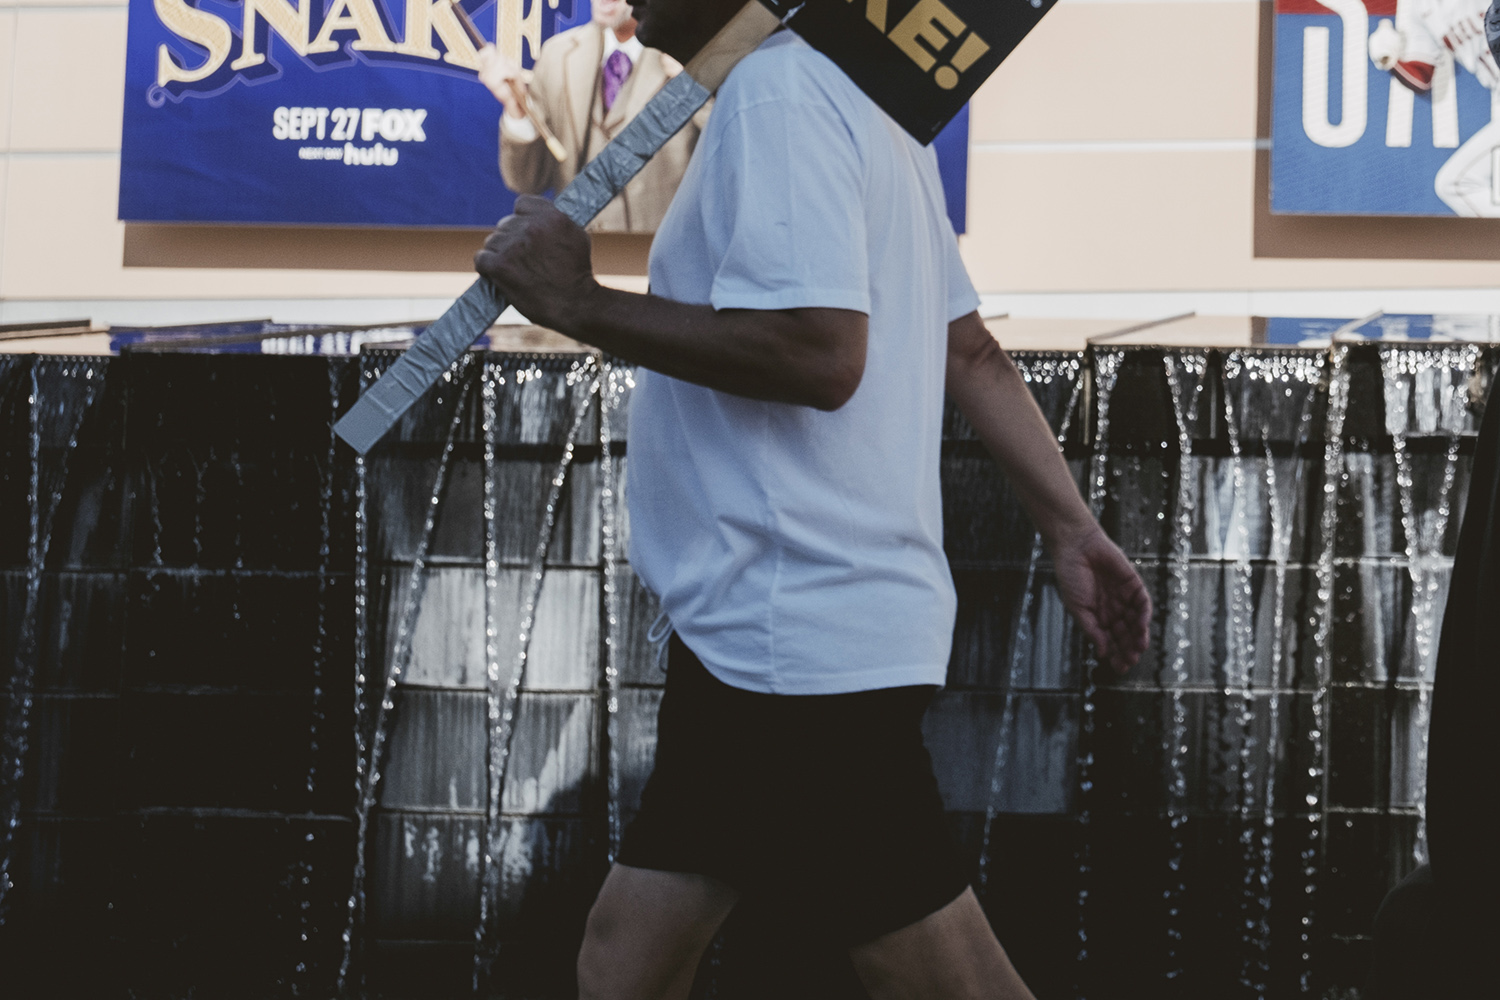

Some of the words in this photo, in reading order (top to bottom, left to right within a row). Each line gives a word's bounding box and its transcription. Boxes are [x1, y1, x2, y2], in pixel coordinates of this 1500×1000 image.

[272, 106, 329, 140] SEPT
[330, 107, 361, 141] 27
[361, 108, 428, 142] FOX
[343, 142, 398, 166] hulu
